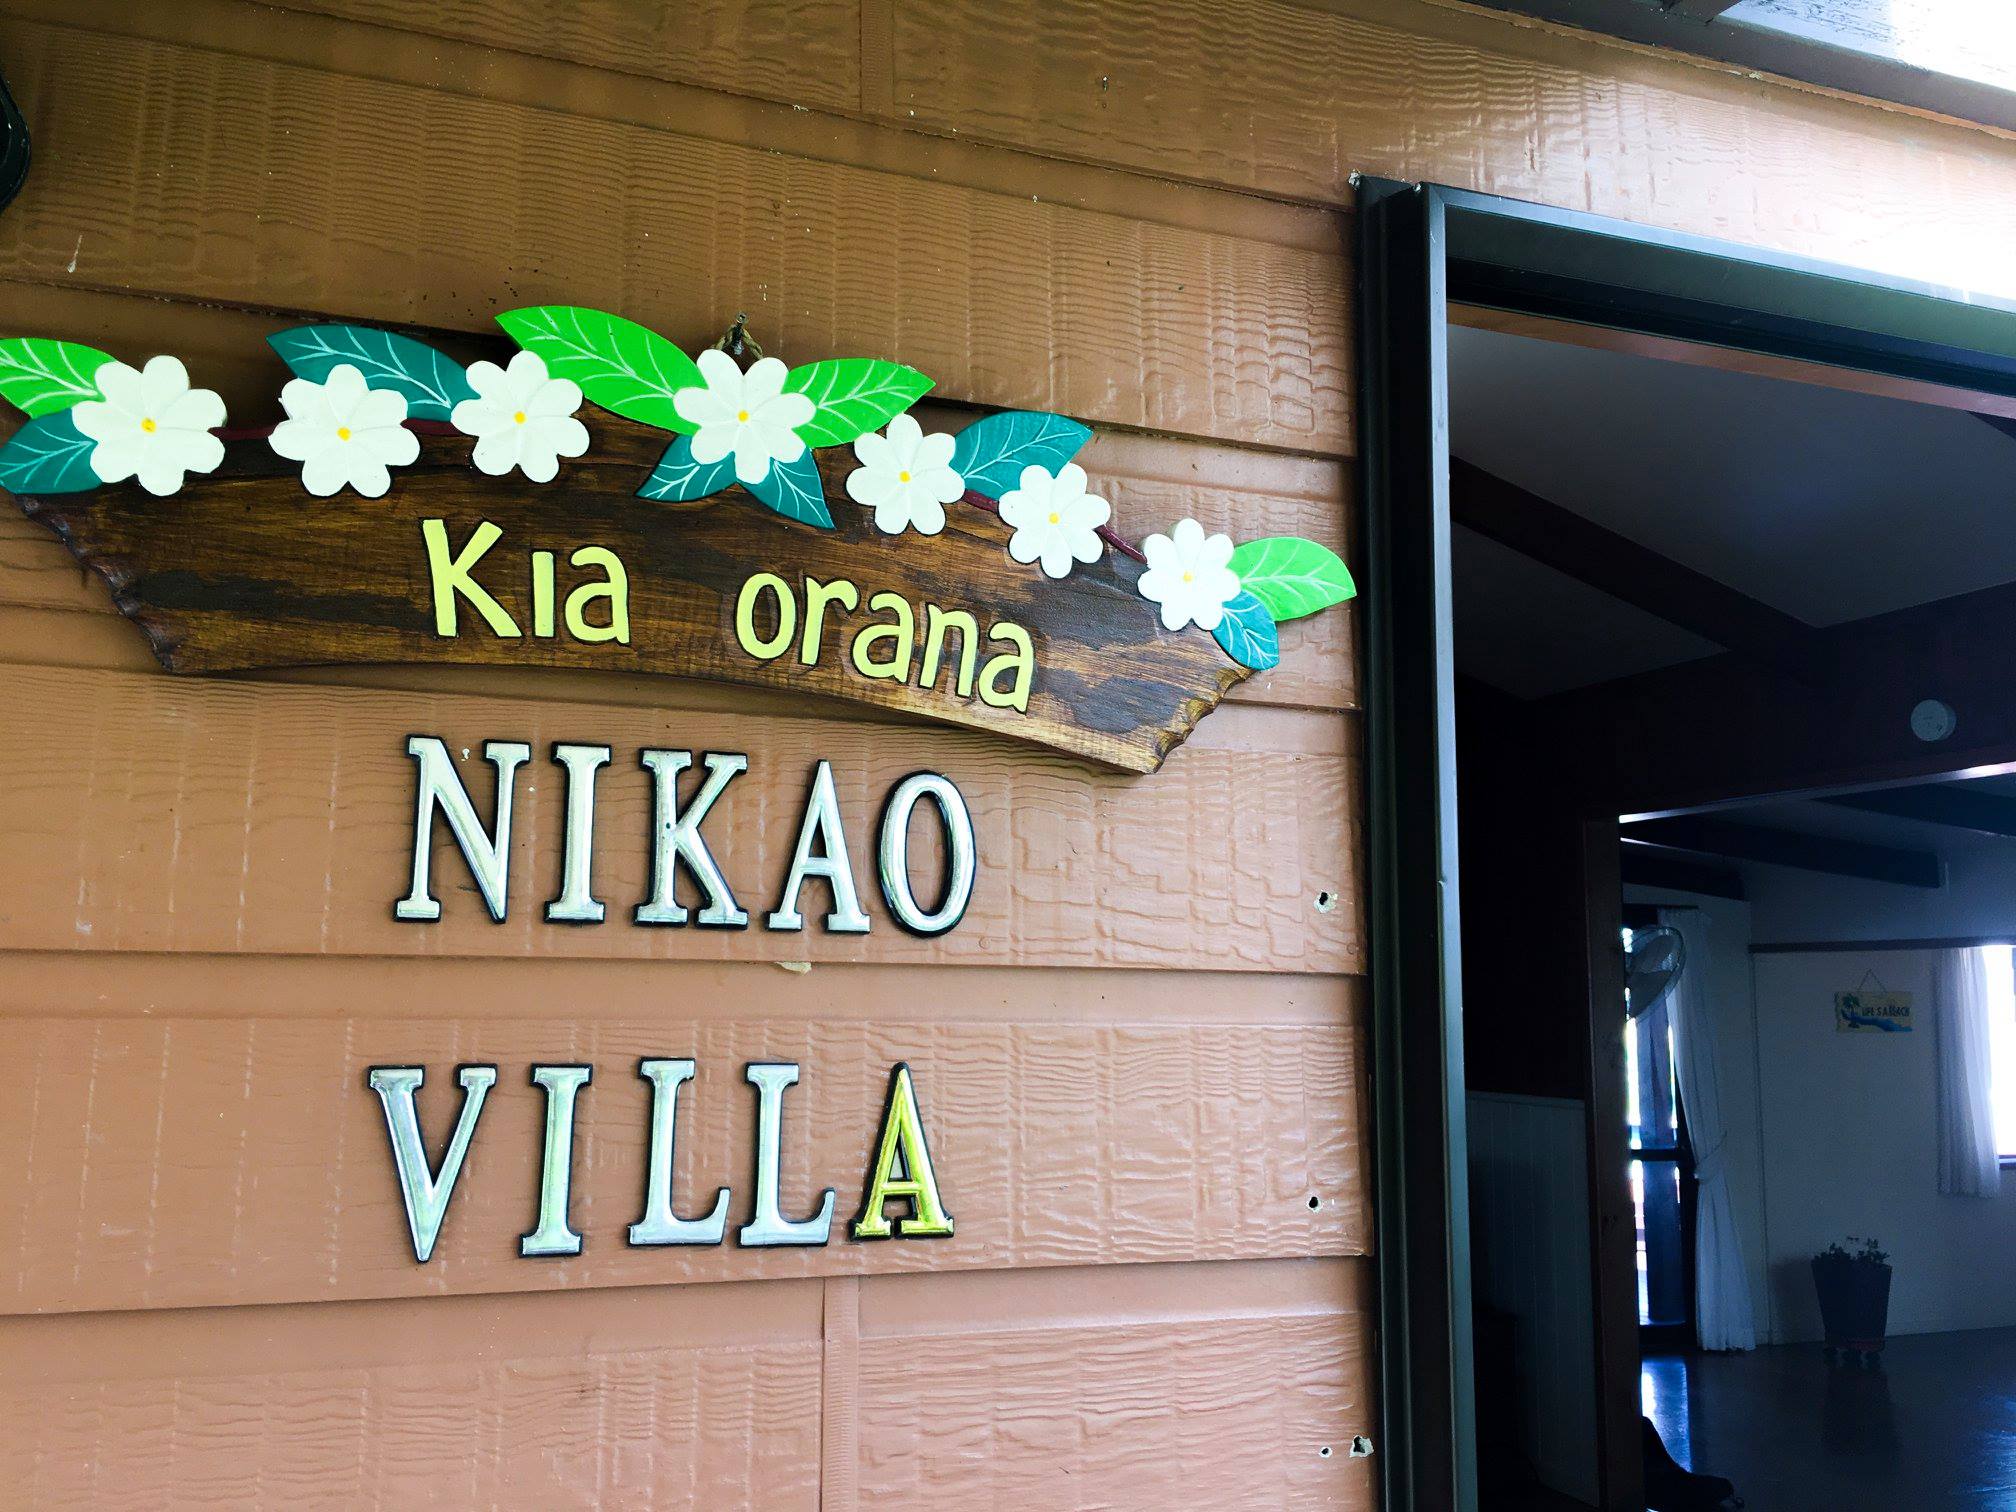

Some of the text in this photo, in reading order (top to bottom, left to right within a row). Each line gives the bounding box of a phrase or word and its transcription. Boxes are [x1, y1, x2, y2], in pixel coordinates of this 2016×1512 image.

[421, 518, 1035, 714] Kia orana
[393, 734, 978, 938] NIKAO
[367, 1056, 956, 1264] VILLA
